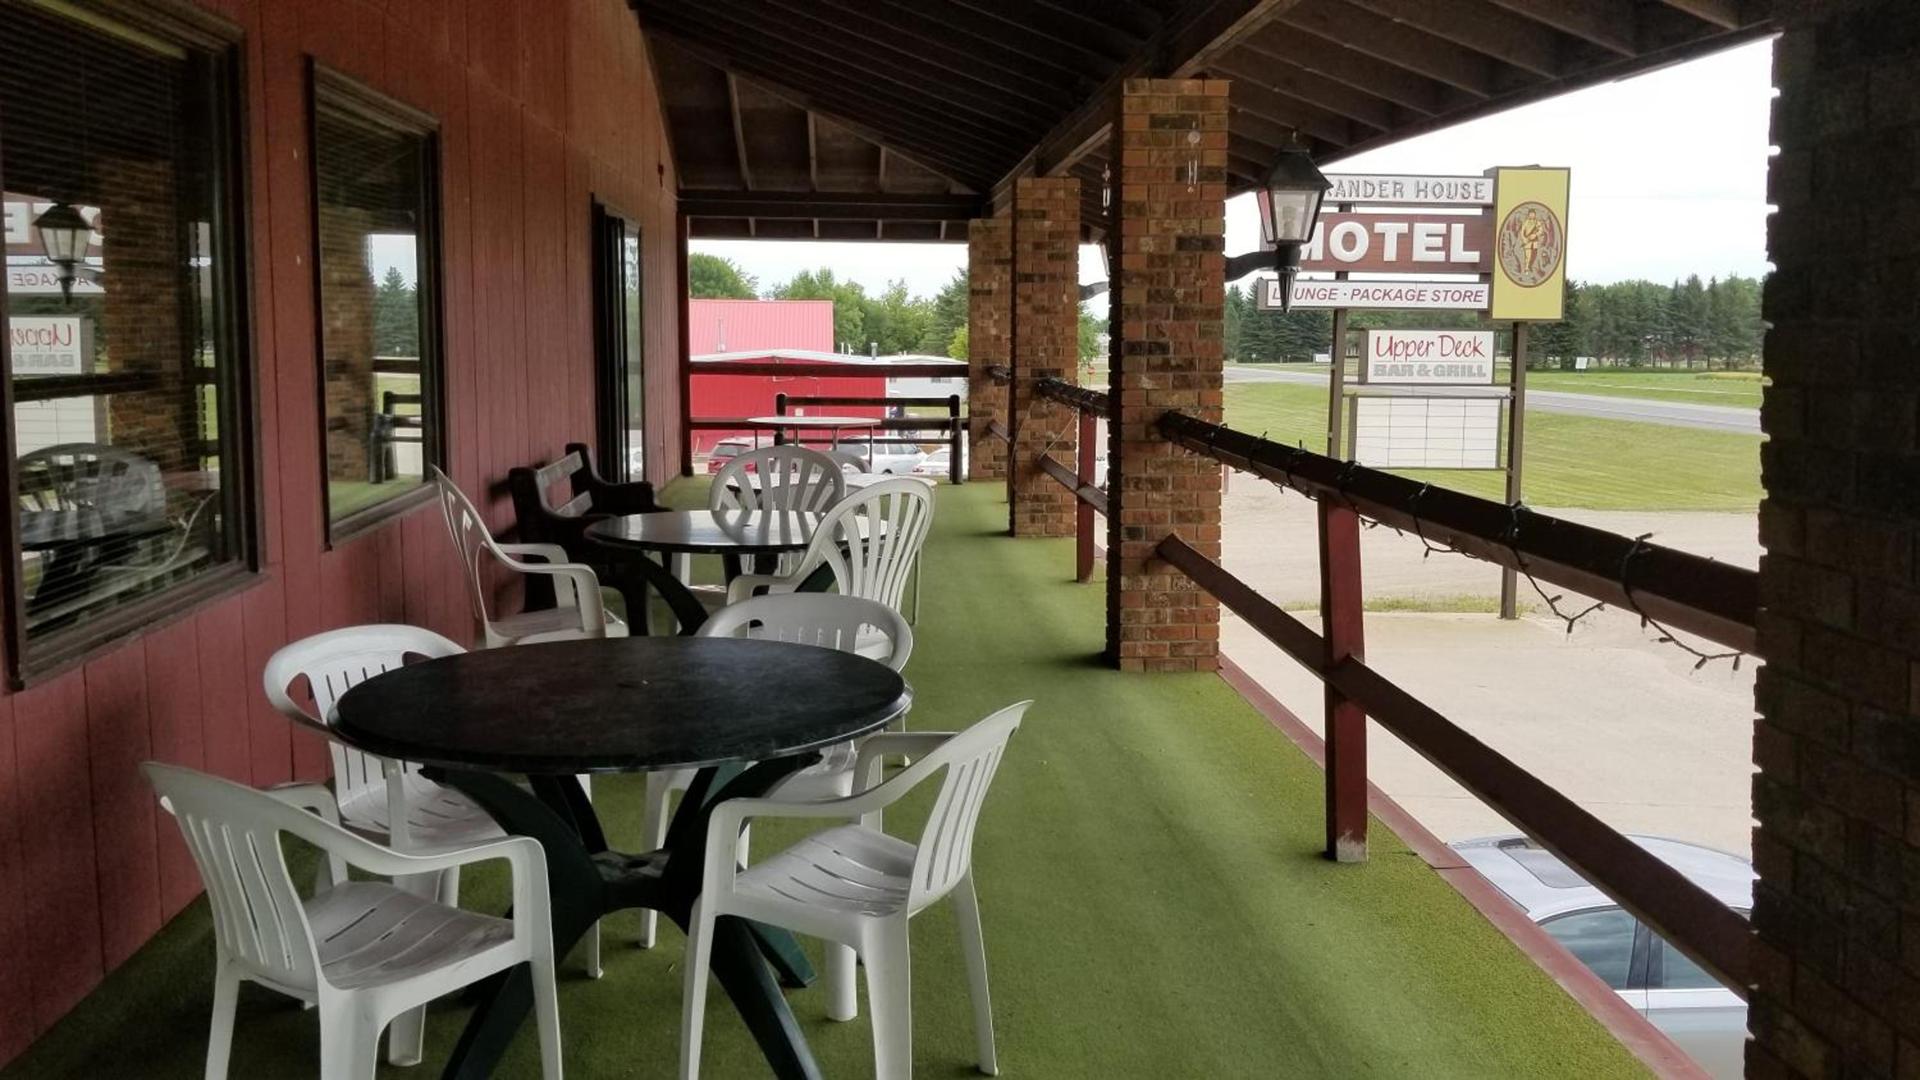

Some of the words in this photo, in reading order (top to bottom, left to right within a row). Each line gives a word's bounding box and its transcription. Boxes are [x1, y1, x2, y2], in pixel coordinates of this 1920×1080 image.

[1327, 179, 1404, 199] ANDER
[1415, 180, 1486, 201] HOUSE
[1271, 287, 1339, 301] LUNGE
[1350, 288, 1427, 302] PACKAGE
[1431, 290, 1484, 303] STORE
[1375, 335, 1435, 362] Upper
[1438, 334, 1486, 358] Deck
[1373, 363, 1414, 377] BAR
[1416, 363, 1432, 377] &
[1433, 364, 1487, 378] GRILL
